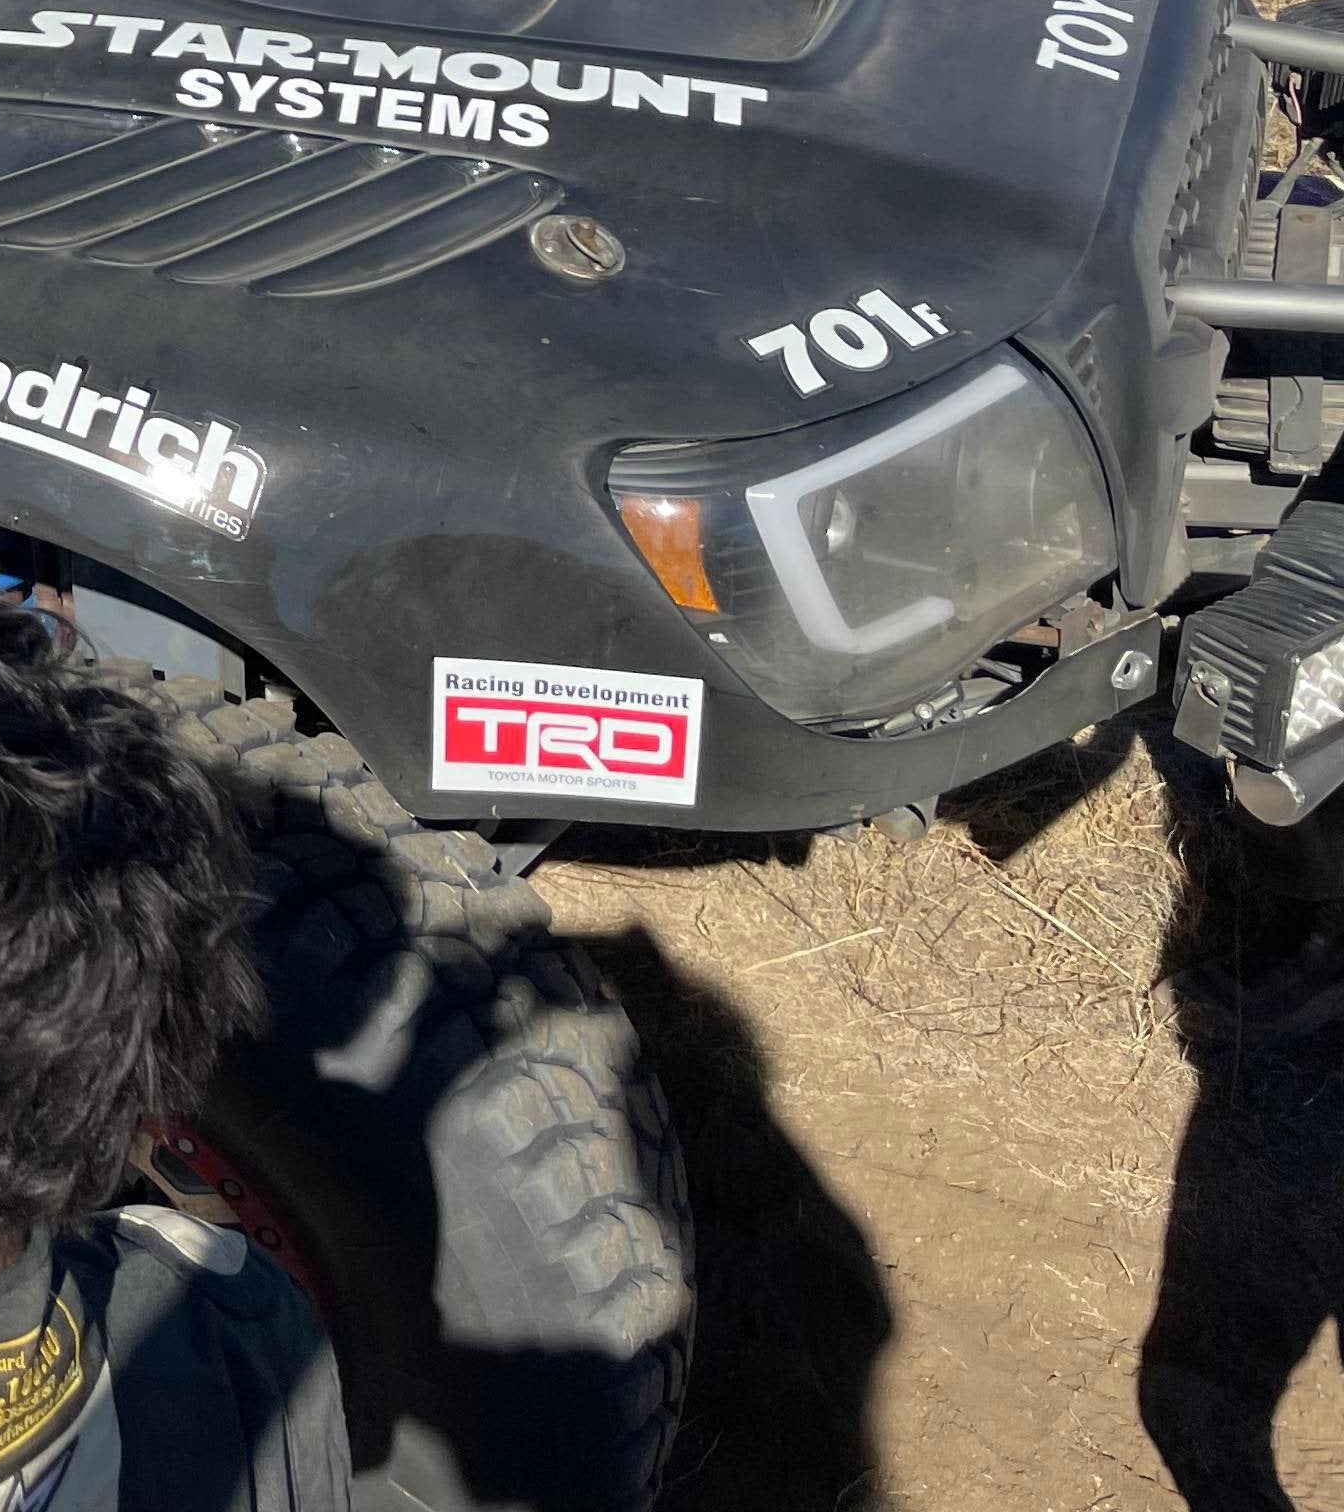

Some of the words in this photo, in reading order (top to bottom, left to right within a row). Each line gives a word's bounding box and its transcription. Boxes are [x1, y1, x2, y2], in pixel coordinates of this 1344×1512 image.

[176, 65, 552, 149] SYSTEMS
[747, 288, 950, 395] 701F
[445, 672, 525, 696] Racing
[534, 678, 690, 710] Development
[457, 707, 674, 773] TRD
[488, 770, 535, 783] TOYOTA
[537, 772, 584, 786] MOTOR
[586, 775, 637, 791] SPORTS
